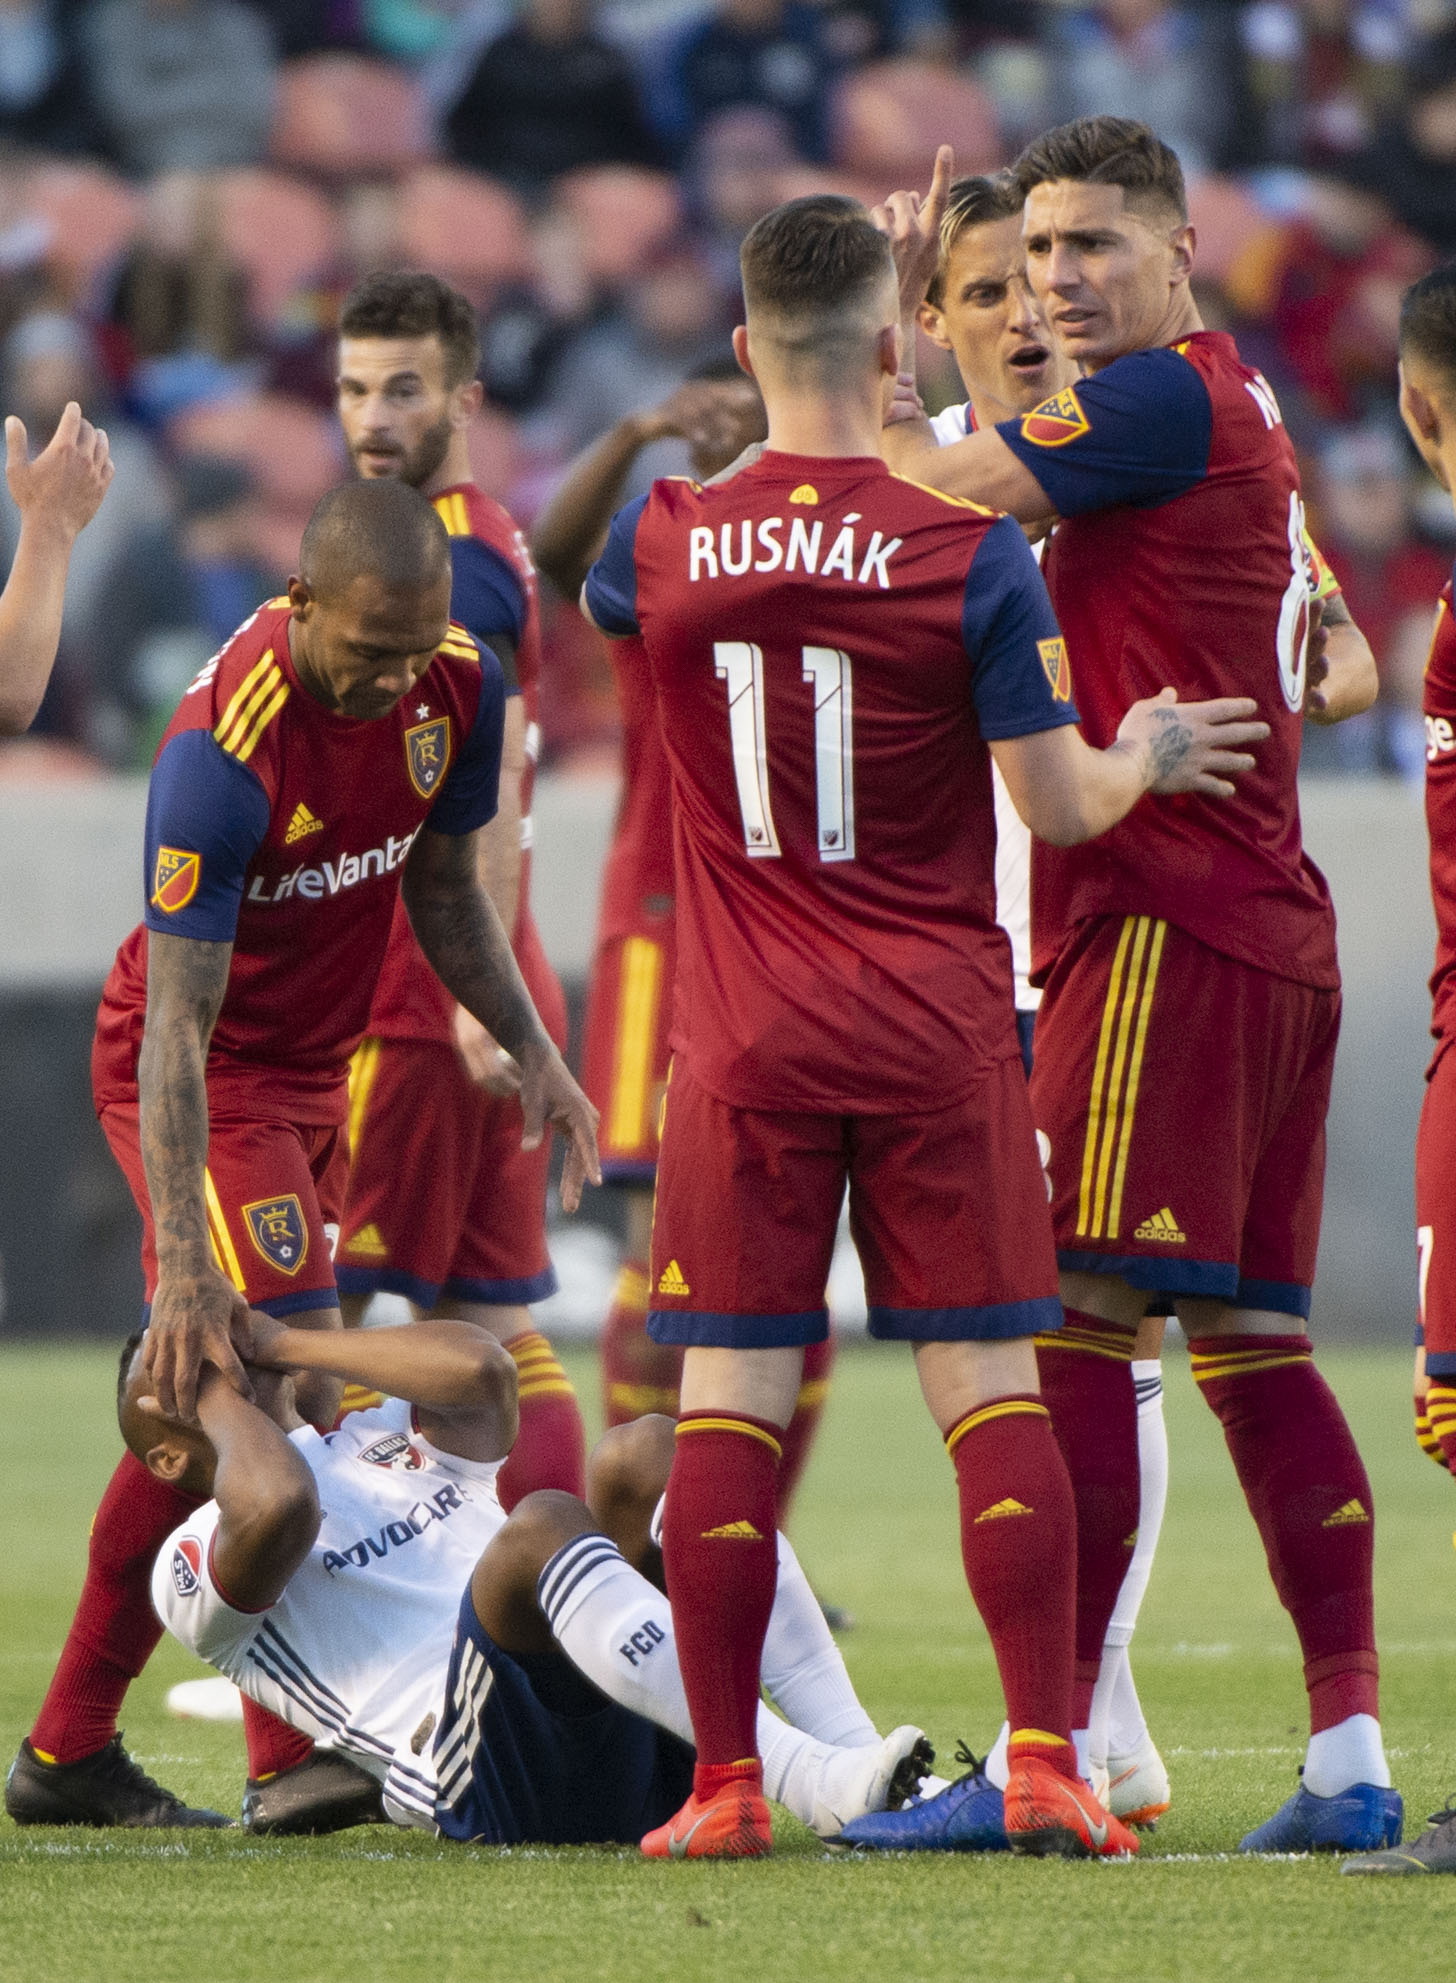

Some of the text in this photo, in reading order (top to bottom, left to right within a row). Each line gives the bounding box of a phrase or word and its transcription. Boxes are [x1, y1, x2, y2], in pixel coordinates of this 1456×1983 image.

[689, 512, 903, 589] RUSNÁK
[713, 641, 855, 863] 11
[285, 819, 323, 845] adidas
[247, 820, 424, 901] LifeVanta
[1134, 1227, 1186, 1243] adidas
[658, 1281, 690, 1295] adidas
[173, 1560, 187, 1589] MLS
[619, 1620, 665, 1667] FCD
